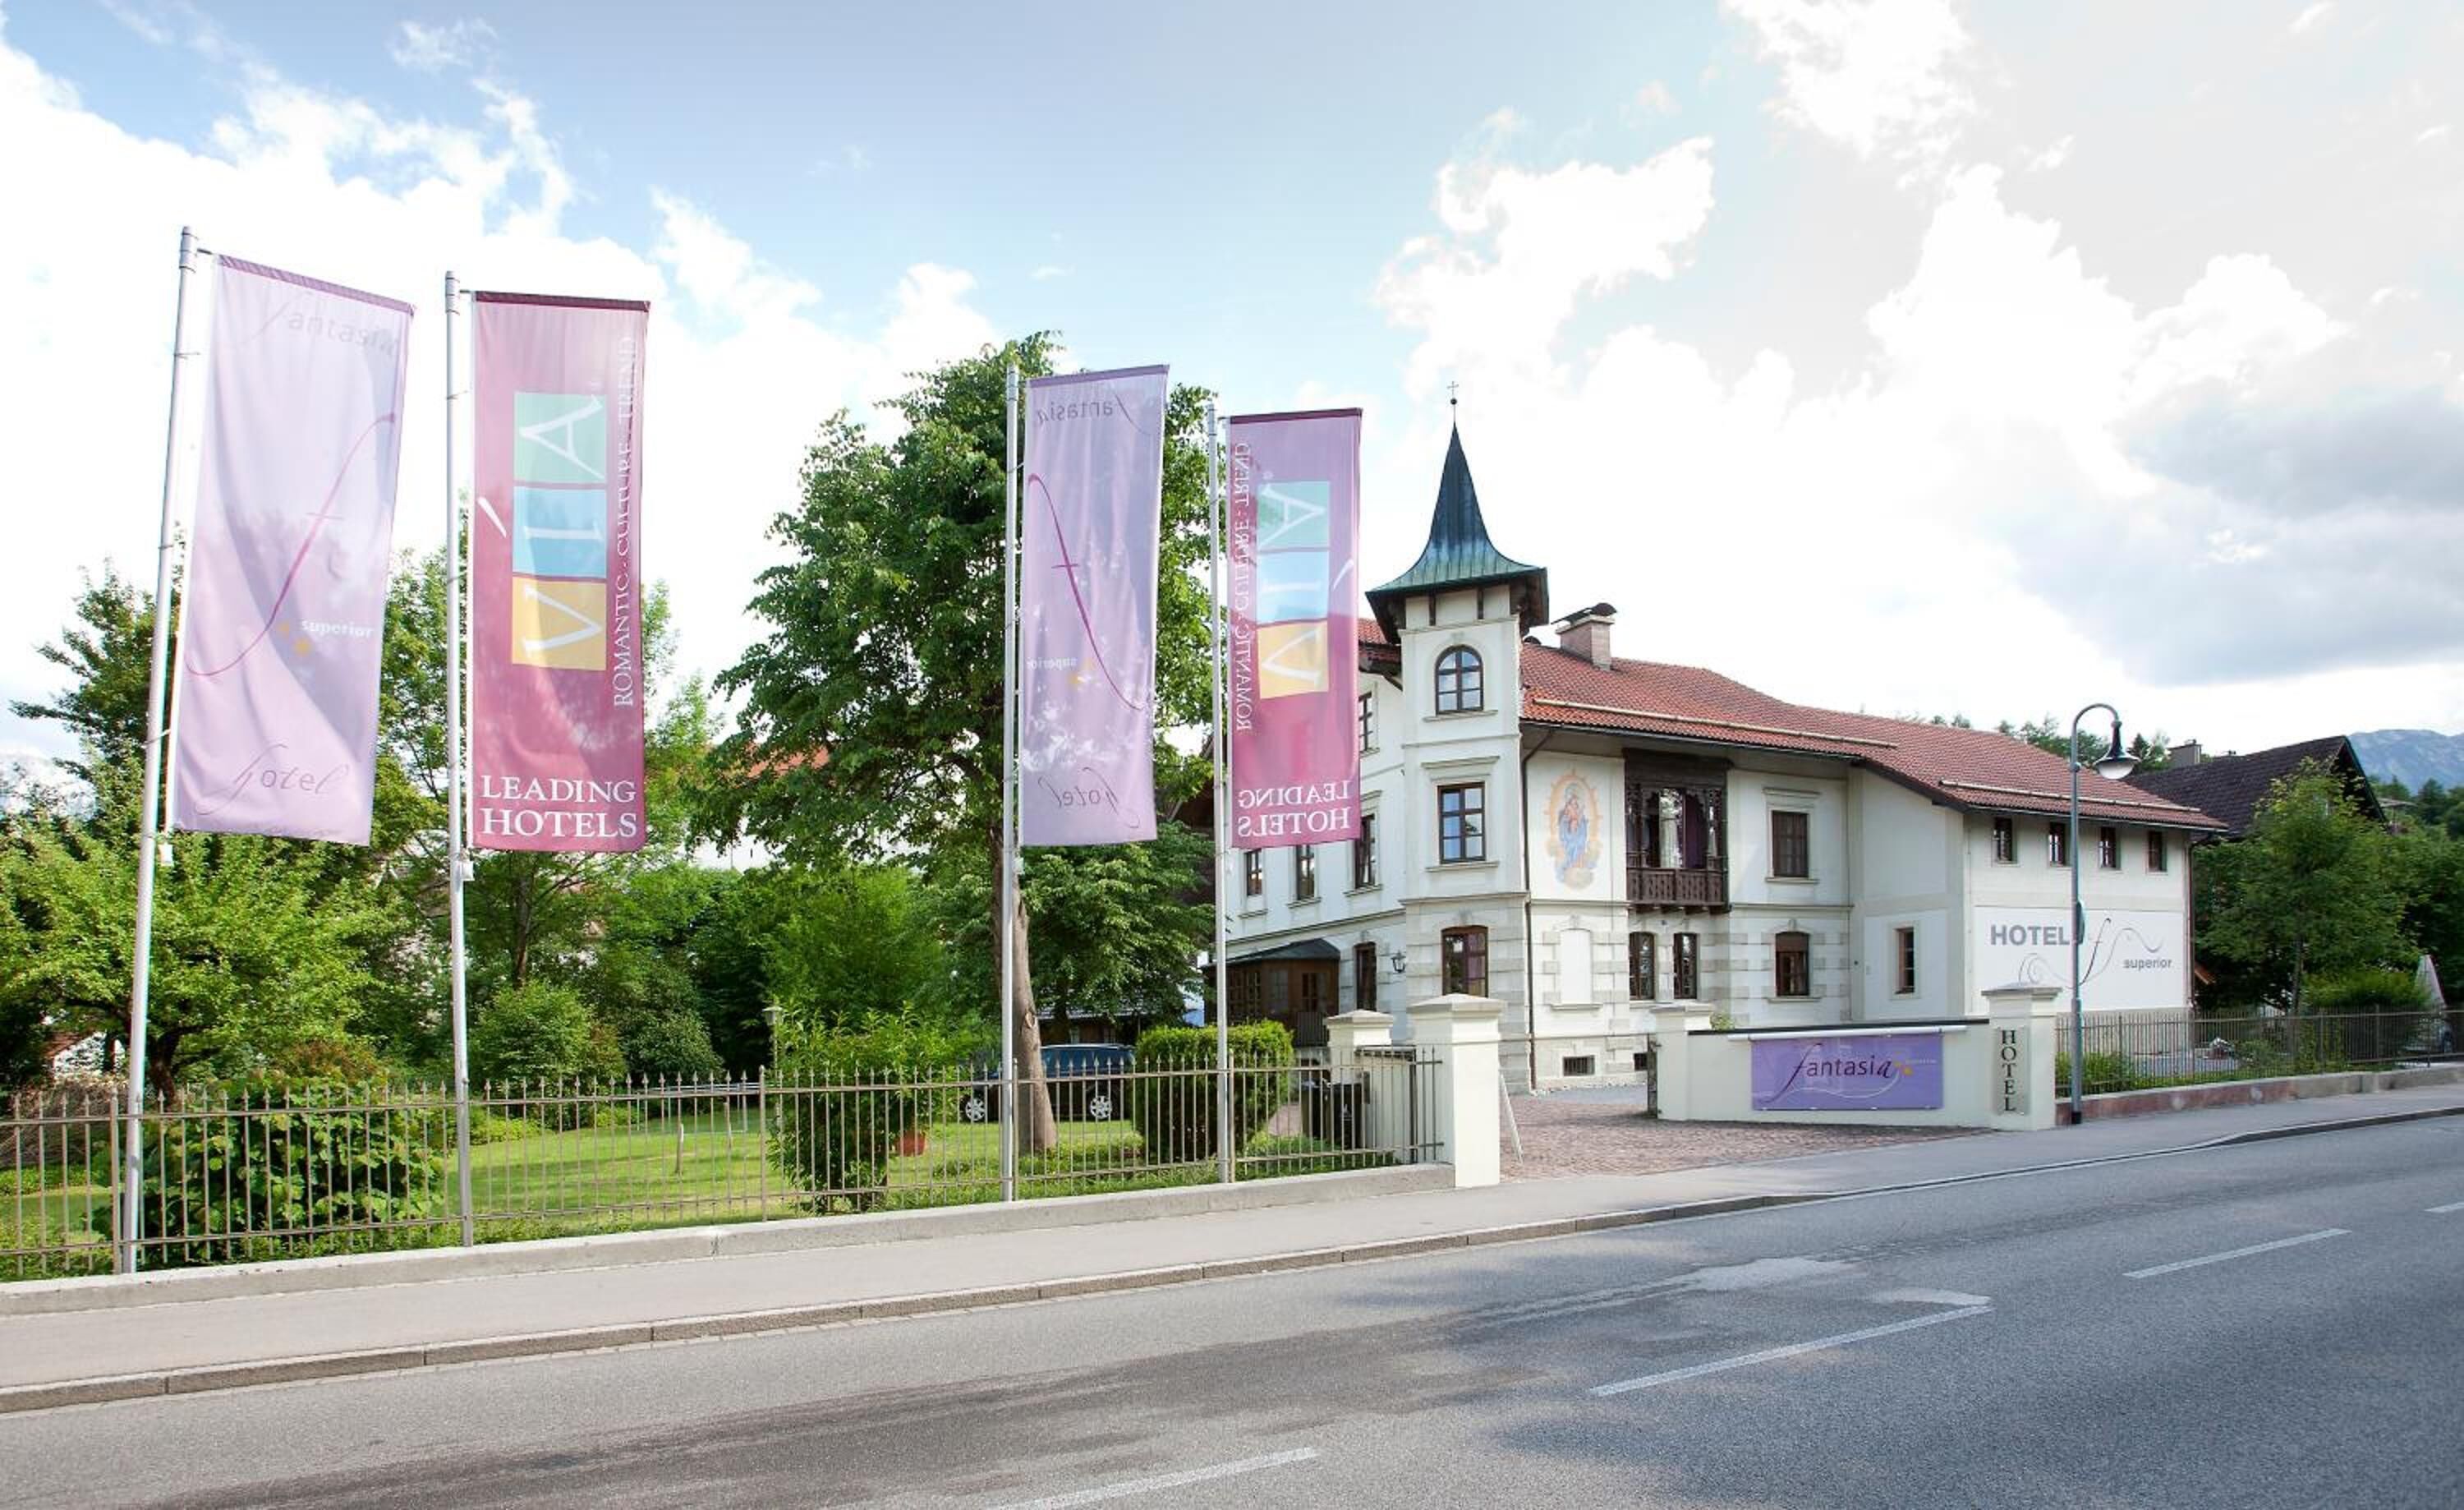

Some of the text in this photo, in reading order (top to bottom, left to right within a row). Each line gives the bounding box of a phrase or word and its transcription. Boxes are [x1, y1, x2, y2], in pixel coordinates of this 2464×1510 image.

[301, 618, 374, 639] superior
[613, 573, 634, 707] ROMANTIC
[480, 775, 637, 803] LEADING
[480, 808, 637, 838] HOTELS
[1990, 924, 2071, 946] HOTEL
[2123, 956, 2172, 971] superior
[1757, 1042, 1892, 1105] fantasia
[2000, 1029, 2017, 1112] HOTEL
